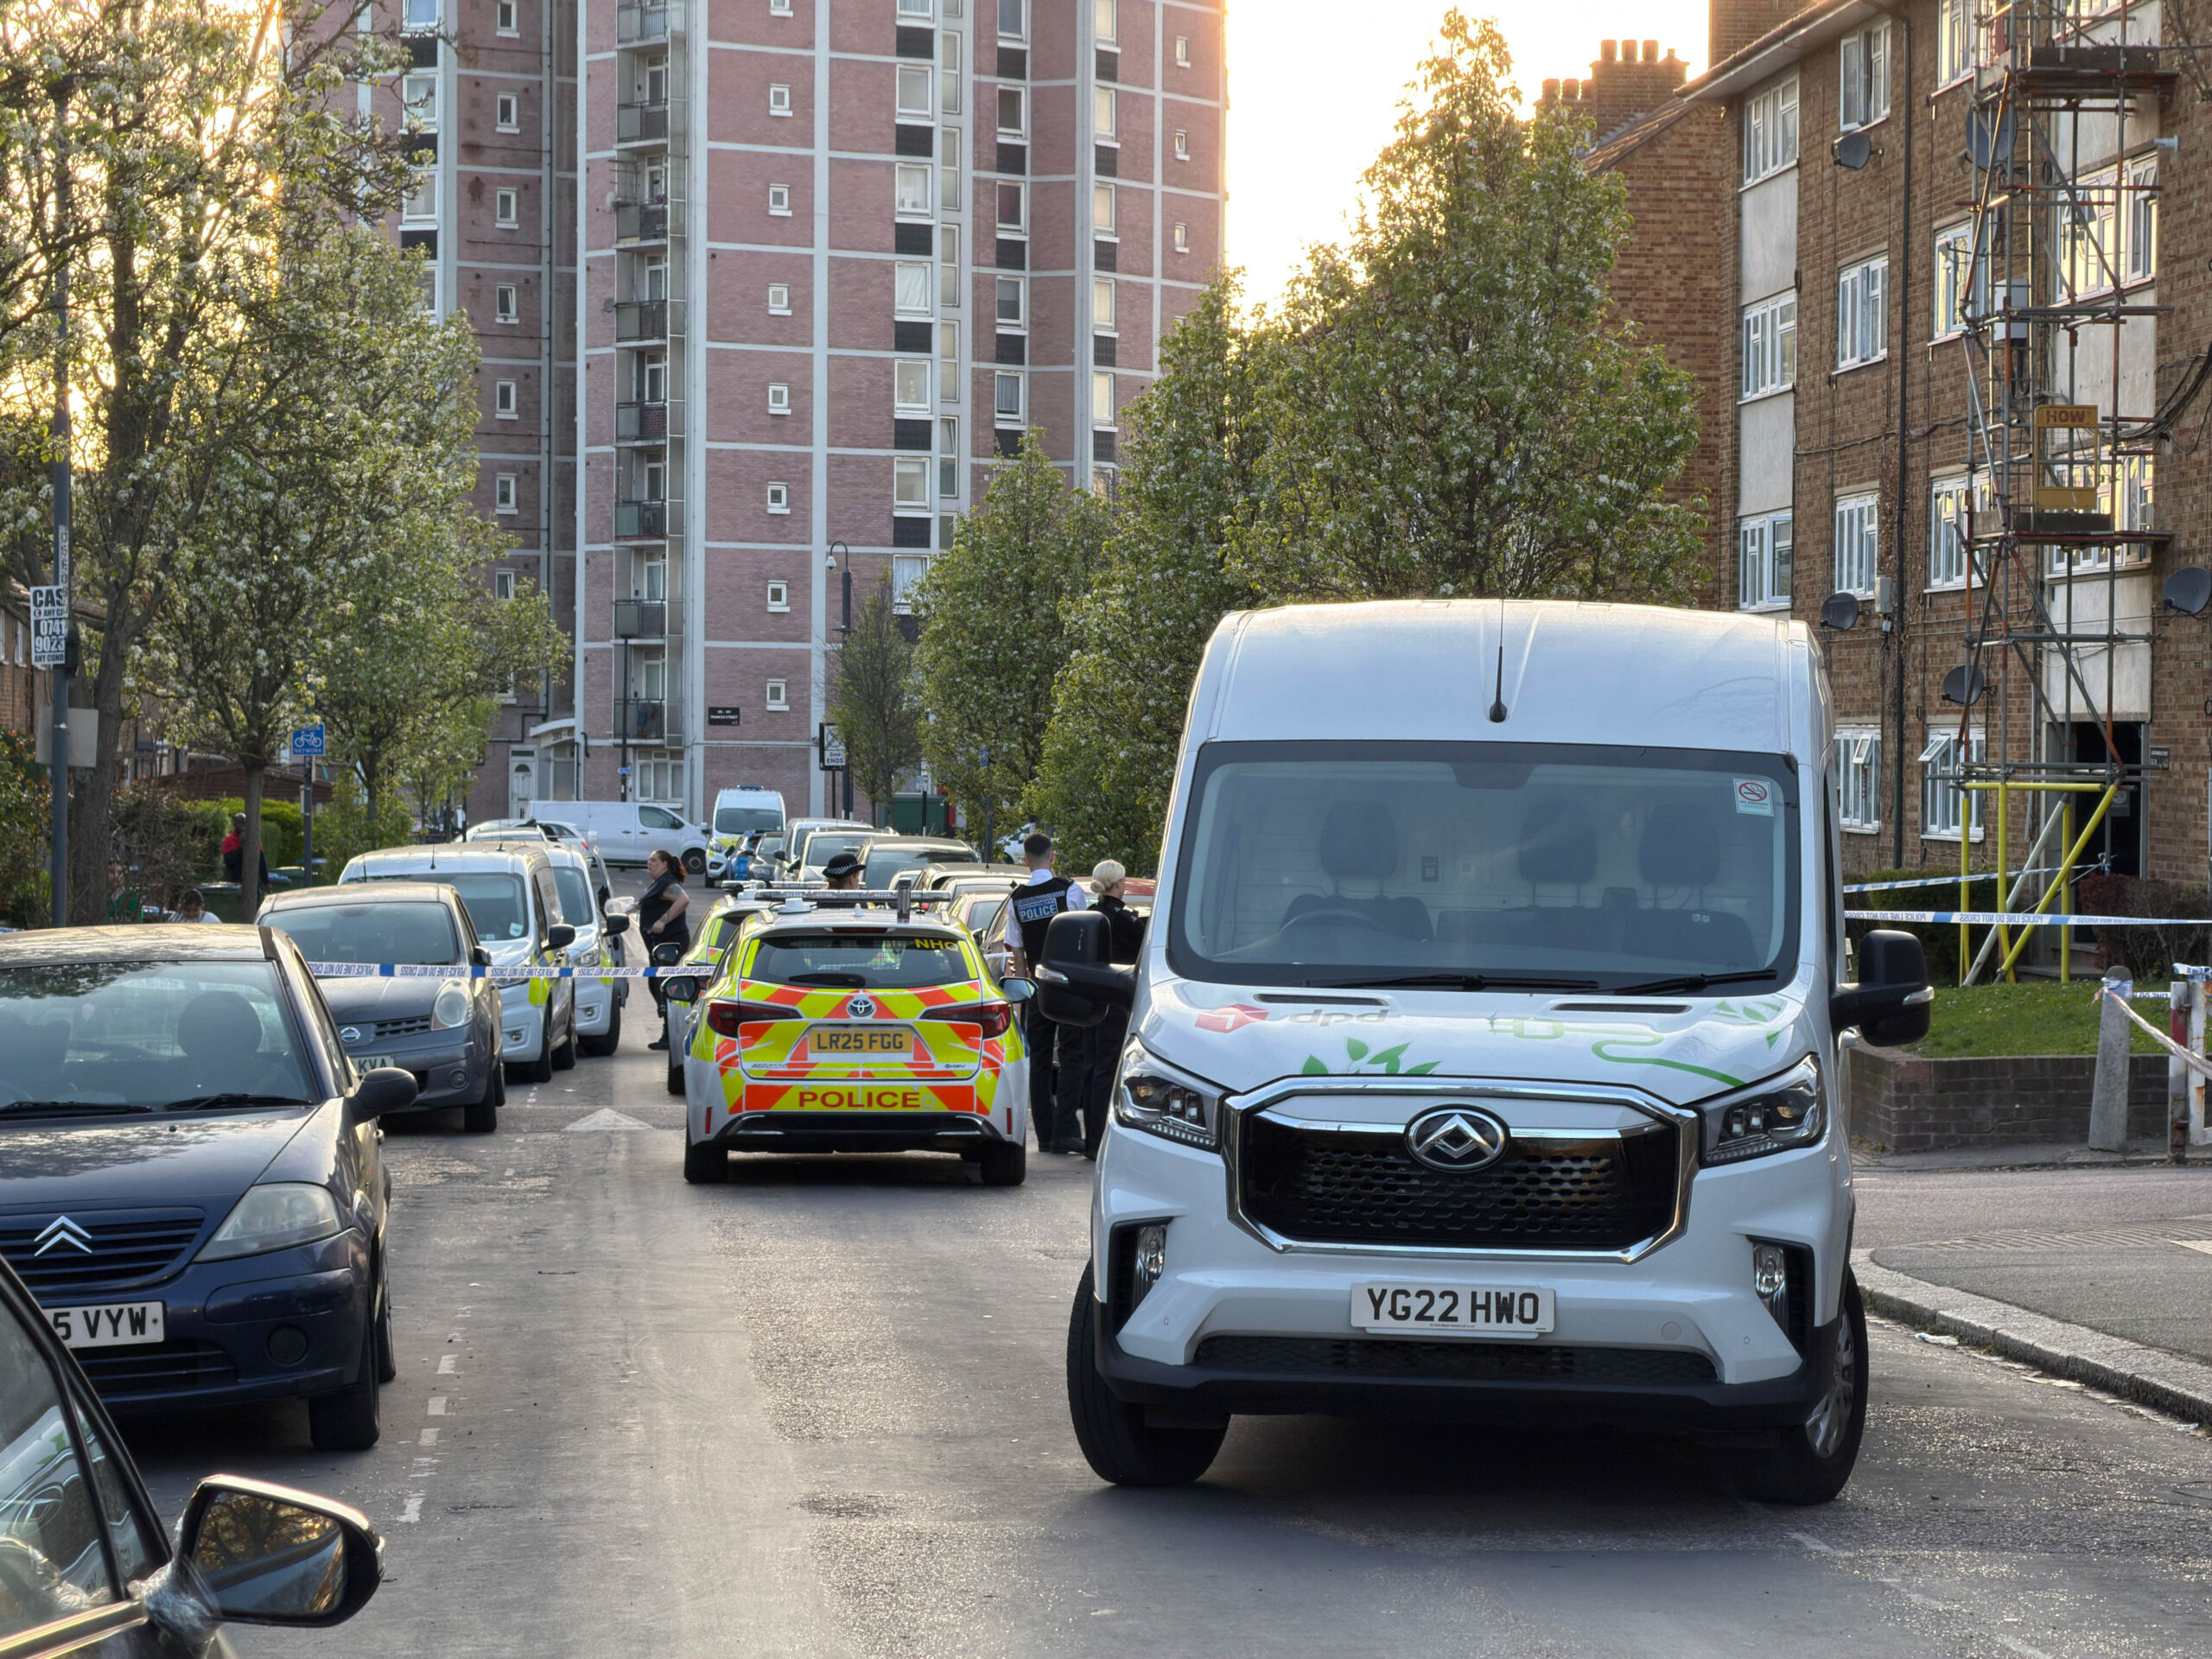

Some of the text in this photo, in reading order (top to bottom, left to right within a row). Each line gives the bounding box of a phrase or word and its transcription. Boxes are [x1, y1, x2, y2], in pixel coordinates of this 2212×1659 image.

[2045, 410, 2086, 423] HOW
[35, 635, 65, 652] 9023
[35, 654, 46, 663] ANY
[1020, 905, 1057, 920] POLICE
[914, 938, 959, 952] NHQ
[1287, 1008, 1389, 1027] dpd
[817, 1033, 904, 1050] LR25 FGG
[798, 1090, 920, 1109] POLICE
[1367, 1287, 1540, 1325] YG22 HWO
[82, 1306, 147, 1339] VYW
